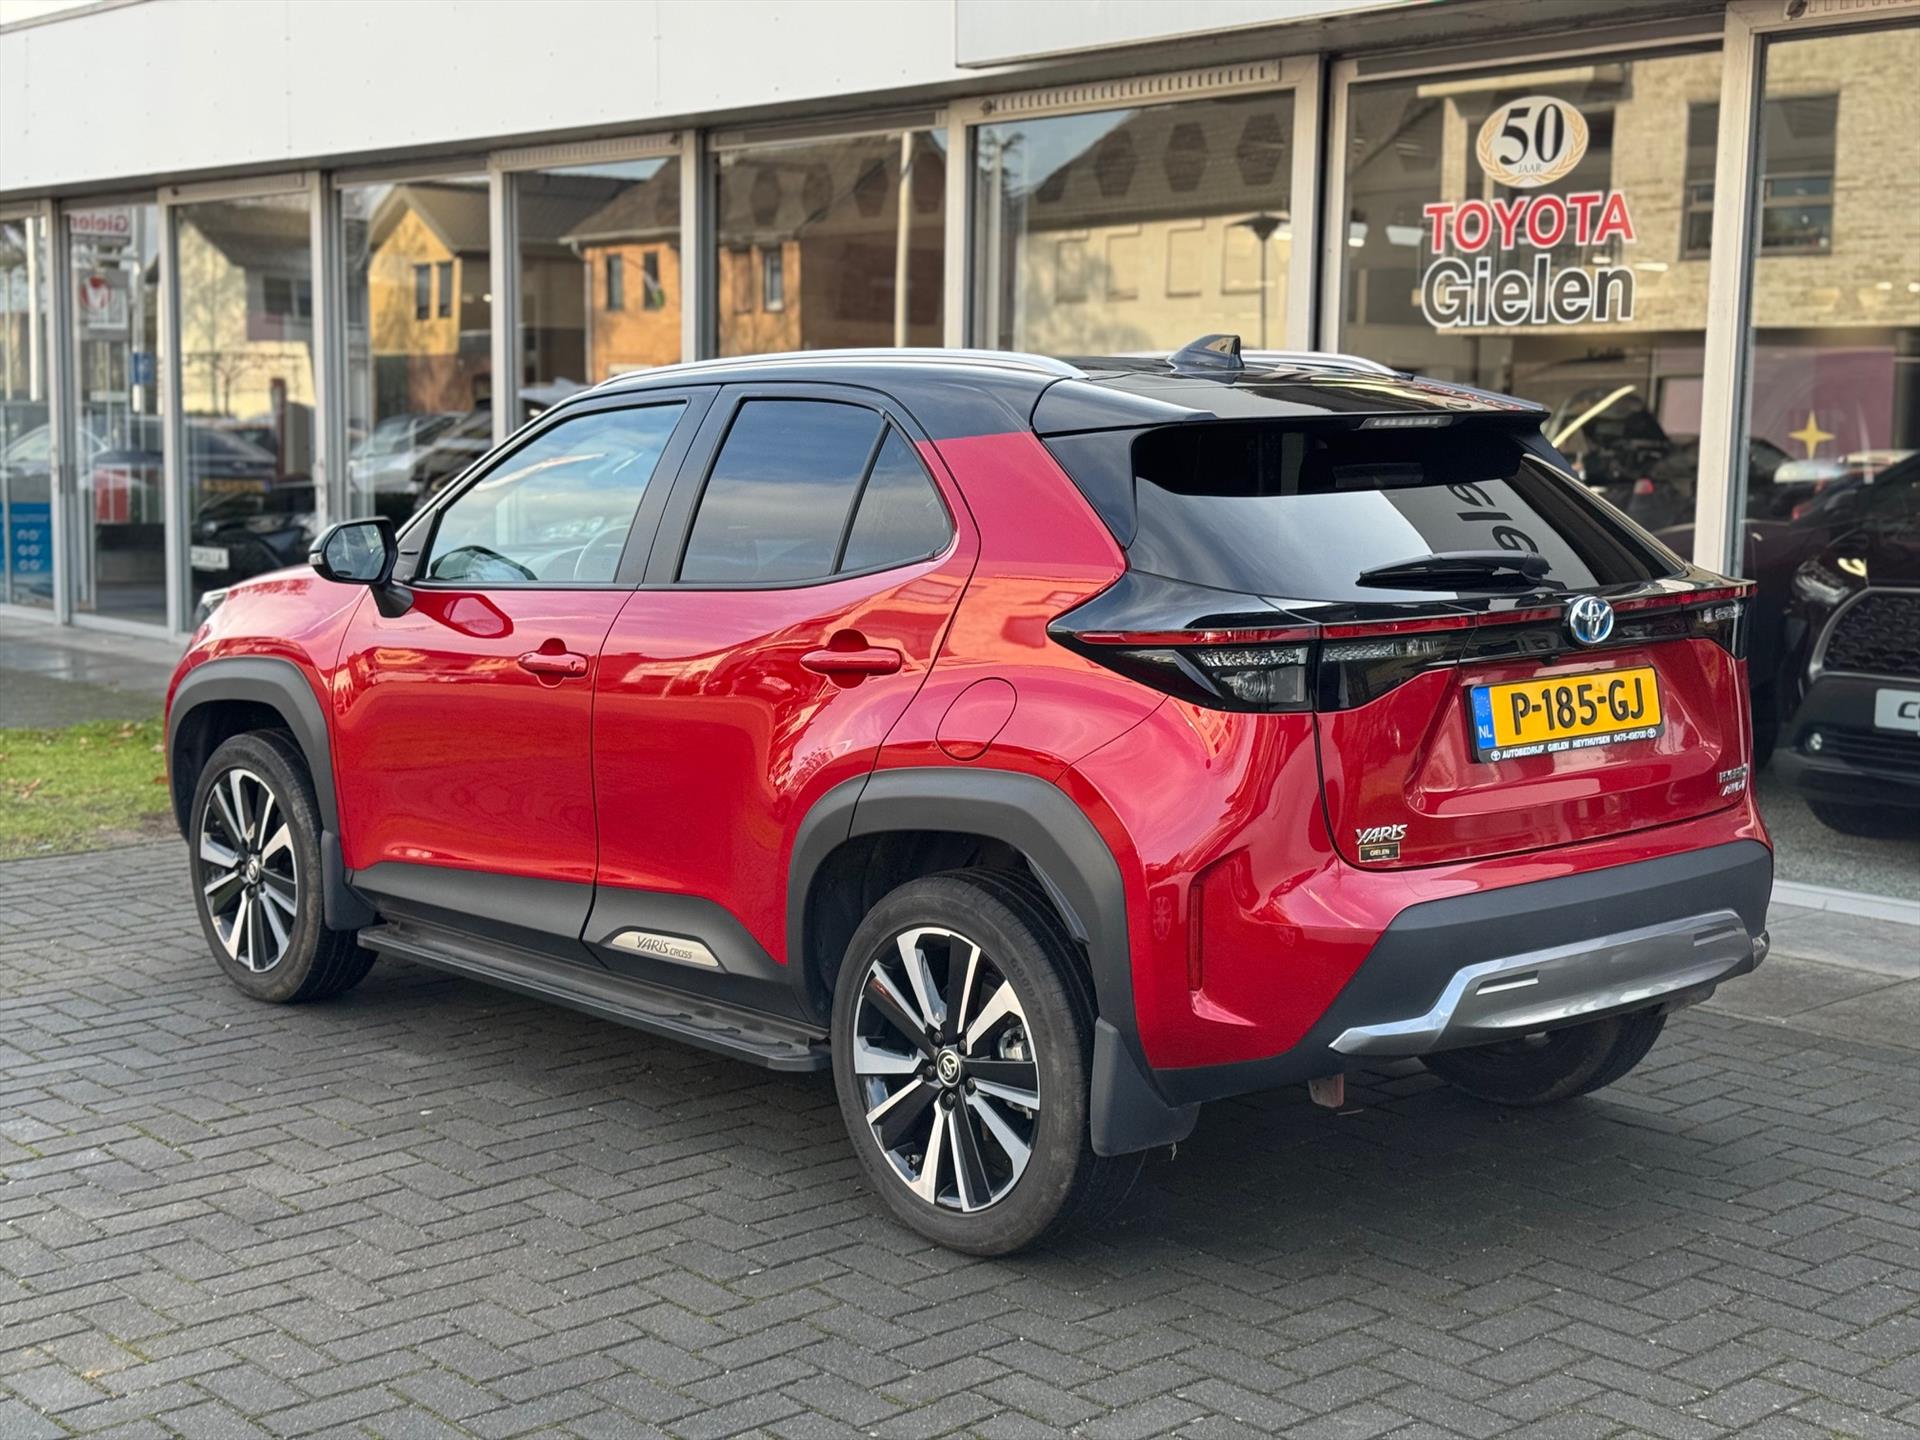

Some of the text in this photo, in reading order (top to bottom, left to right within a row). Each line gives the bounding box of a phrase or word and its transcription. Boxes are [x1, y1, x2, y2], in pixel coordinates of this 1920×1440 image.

[1499, 103, 1565, 166] 50
[1517, 162, 1543, 174] JAAR
[1423, 189, 1637, 254] TOYOTA
[1421, 252, 1636, 328] Gielen
[1510, 677, 1645, 736] P-185-GJ
[1478, 725, 1493, 739] NL
[1547, 740, 1570, 752] GIELEN
[1355, 823, 1408, 846] YARIS
[636, 935, 693, 960] YARIS CROSS
